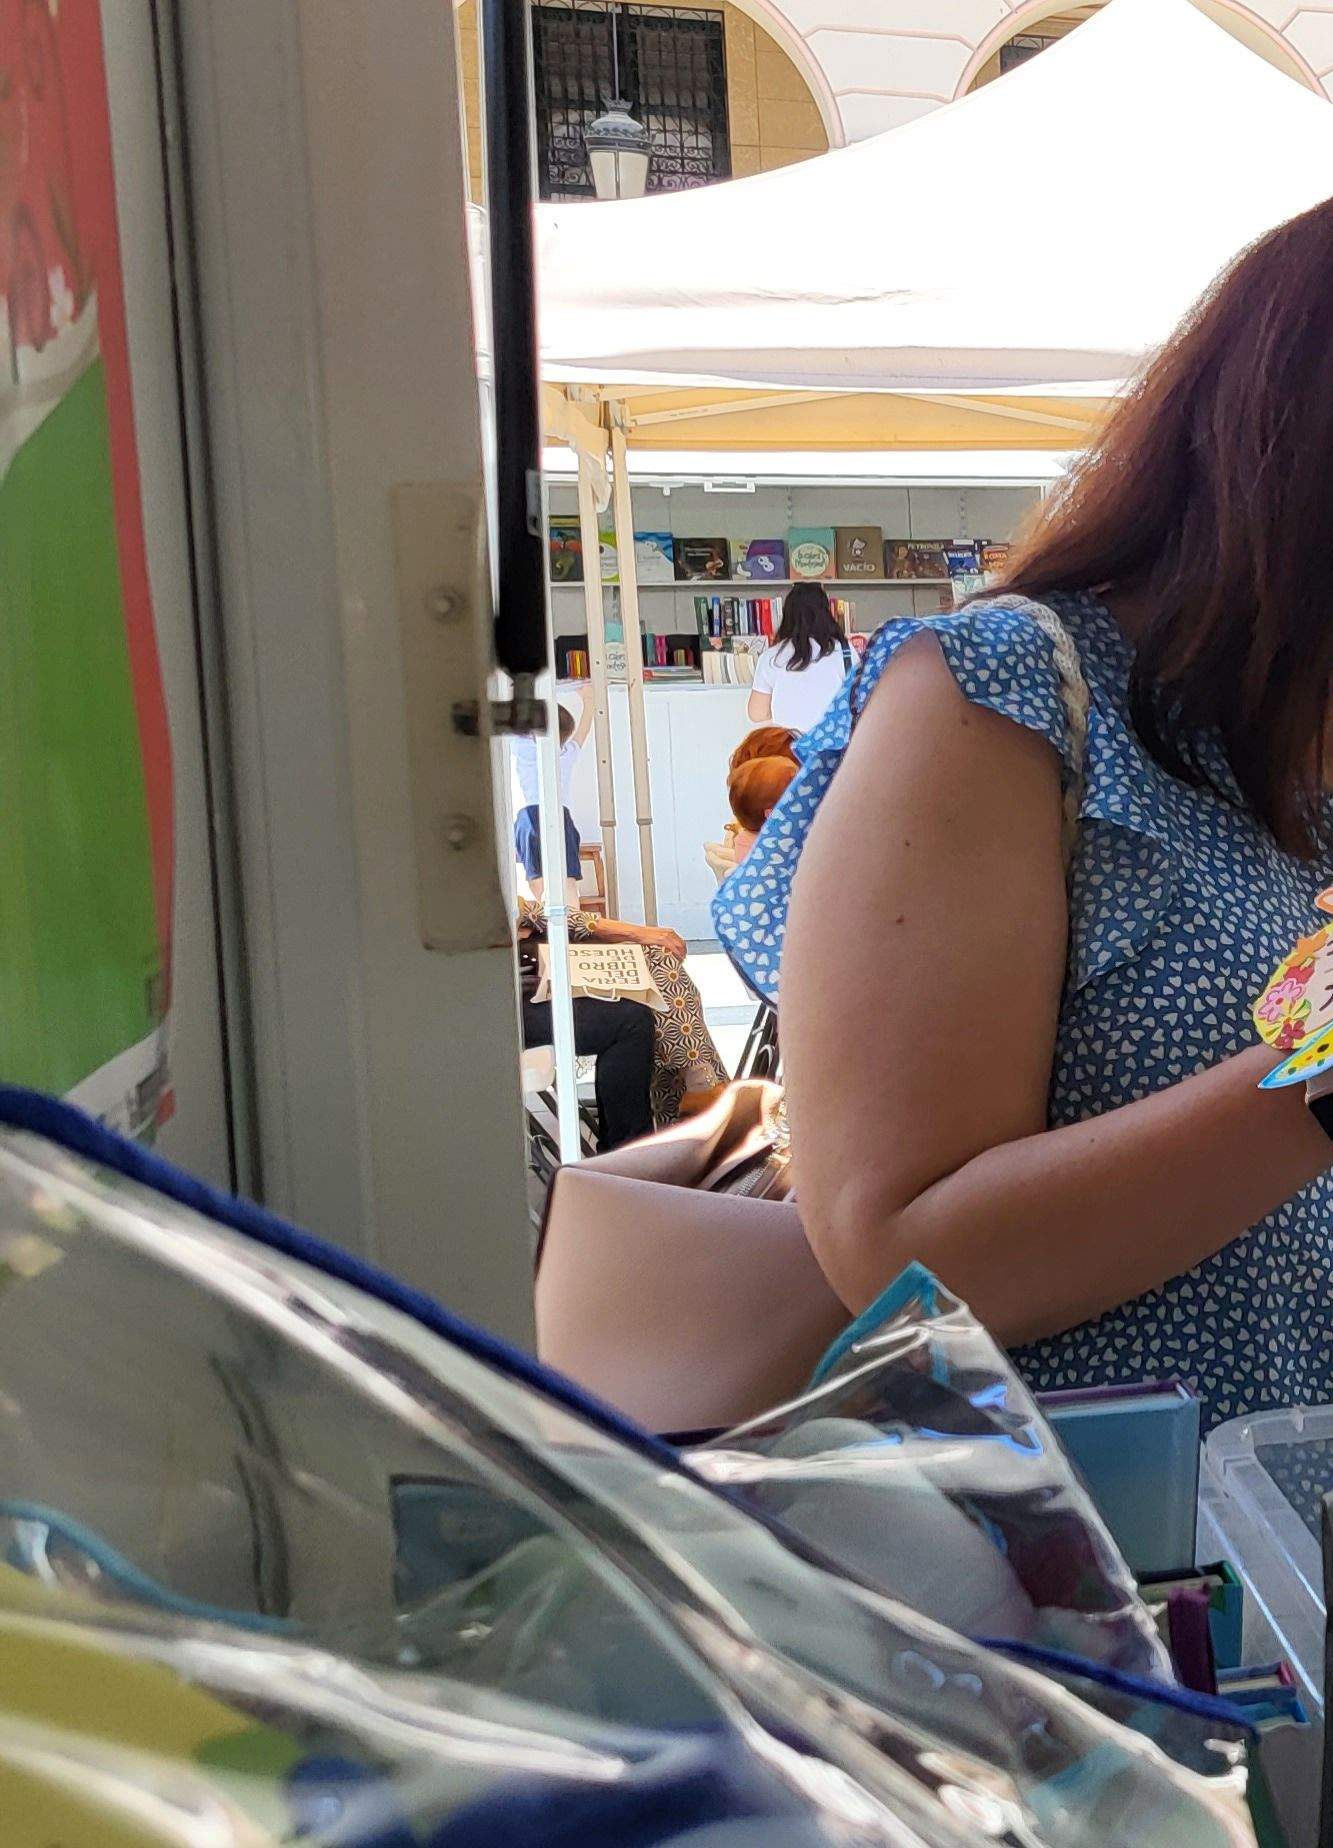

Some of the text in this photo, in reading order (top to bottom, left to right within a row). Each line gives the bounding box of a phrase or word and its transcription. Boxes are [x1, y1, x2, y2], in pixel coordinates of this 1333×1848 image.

[569, 949, 634, 957] HUESC
[578, 962, 637, 970] LIBRO
[582, 977, 640, 985] FERIA
